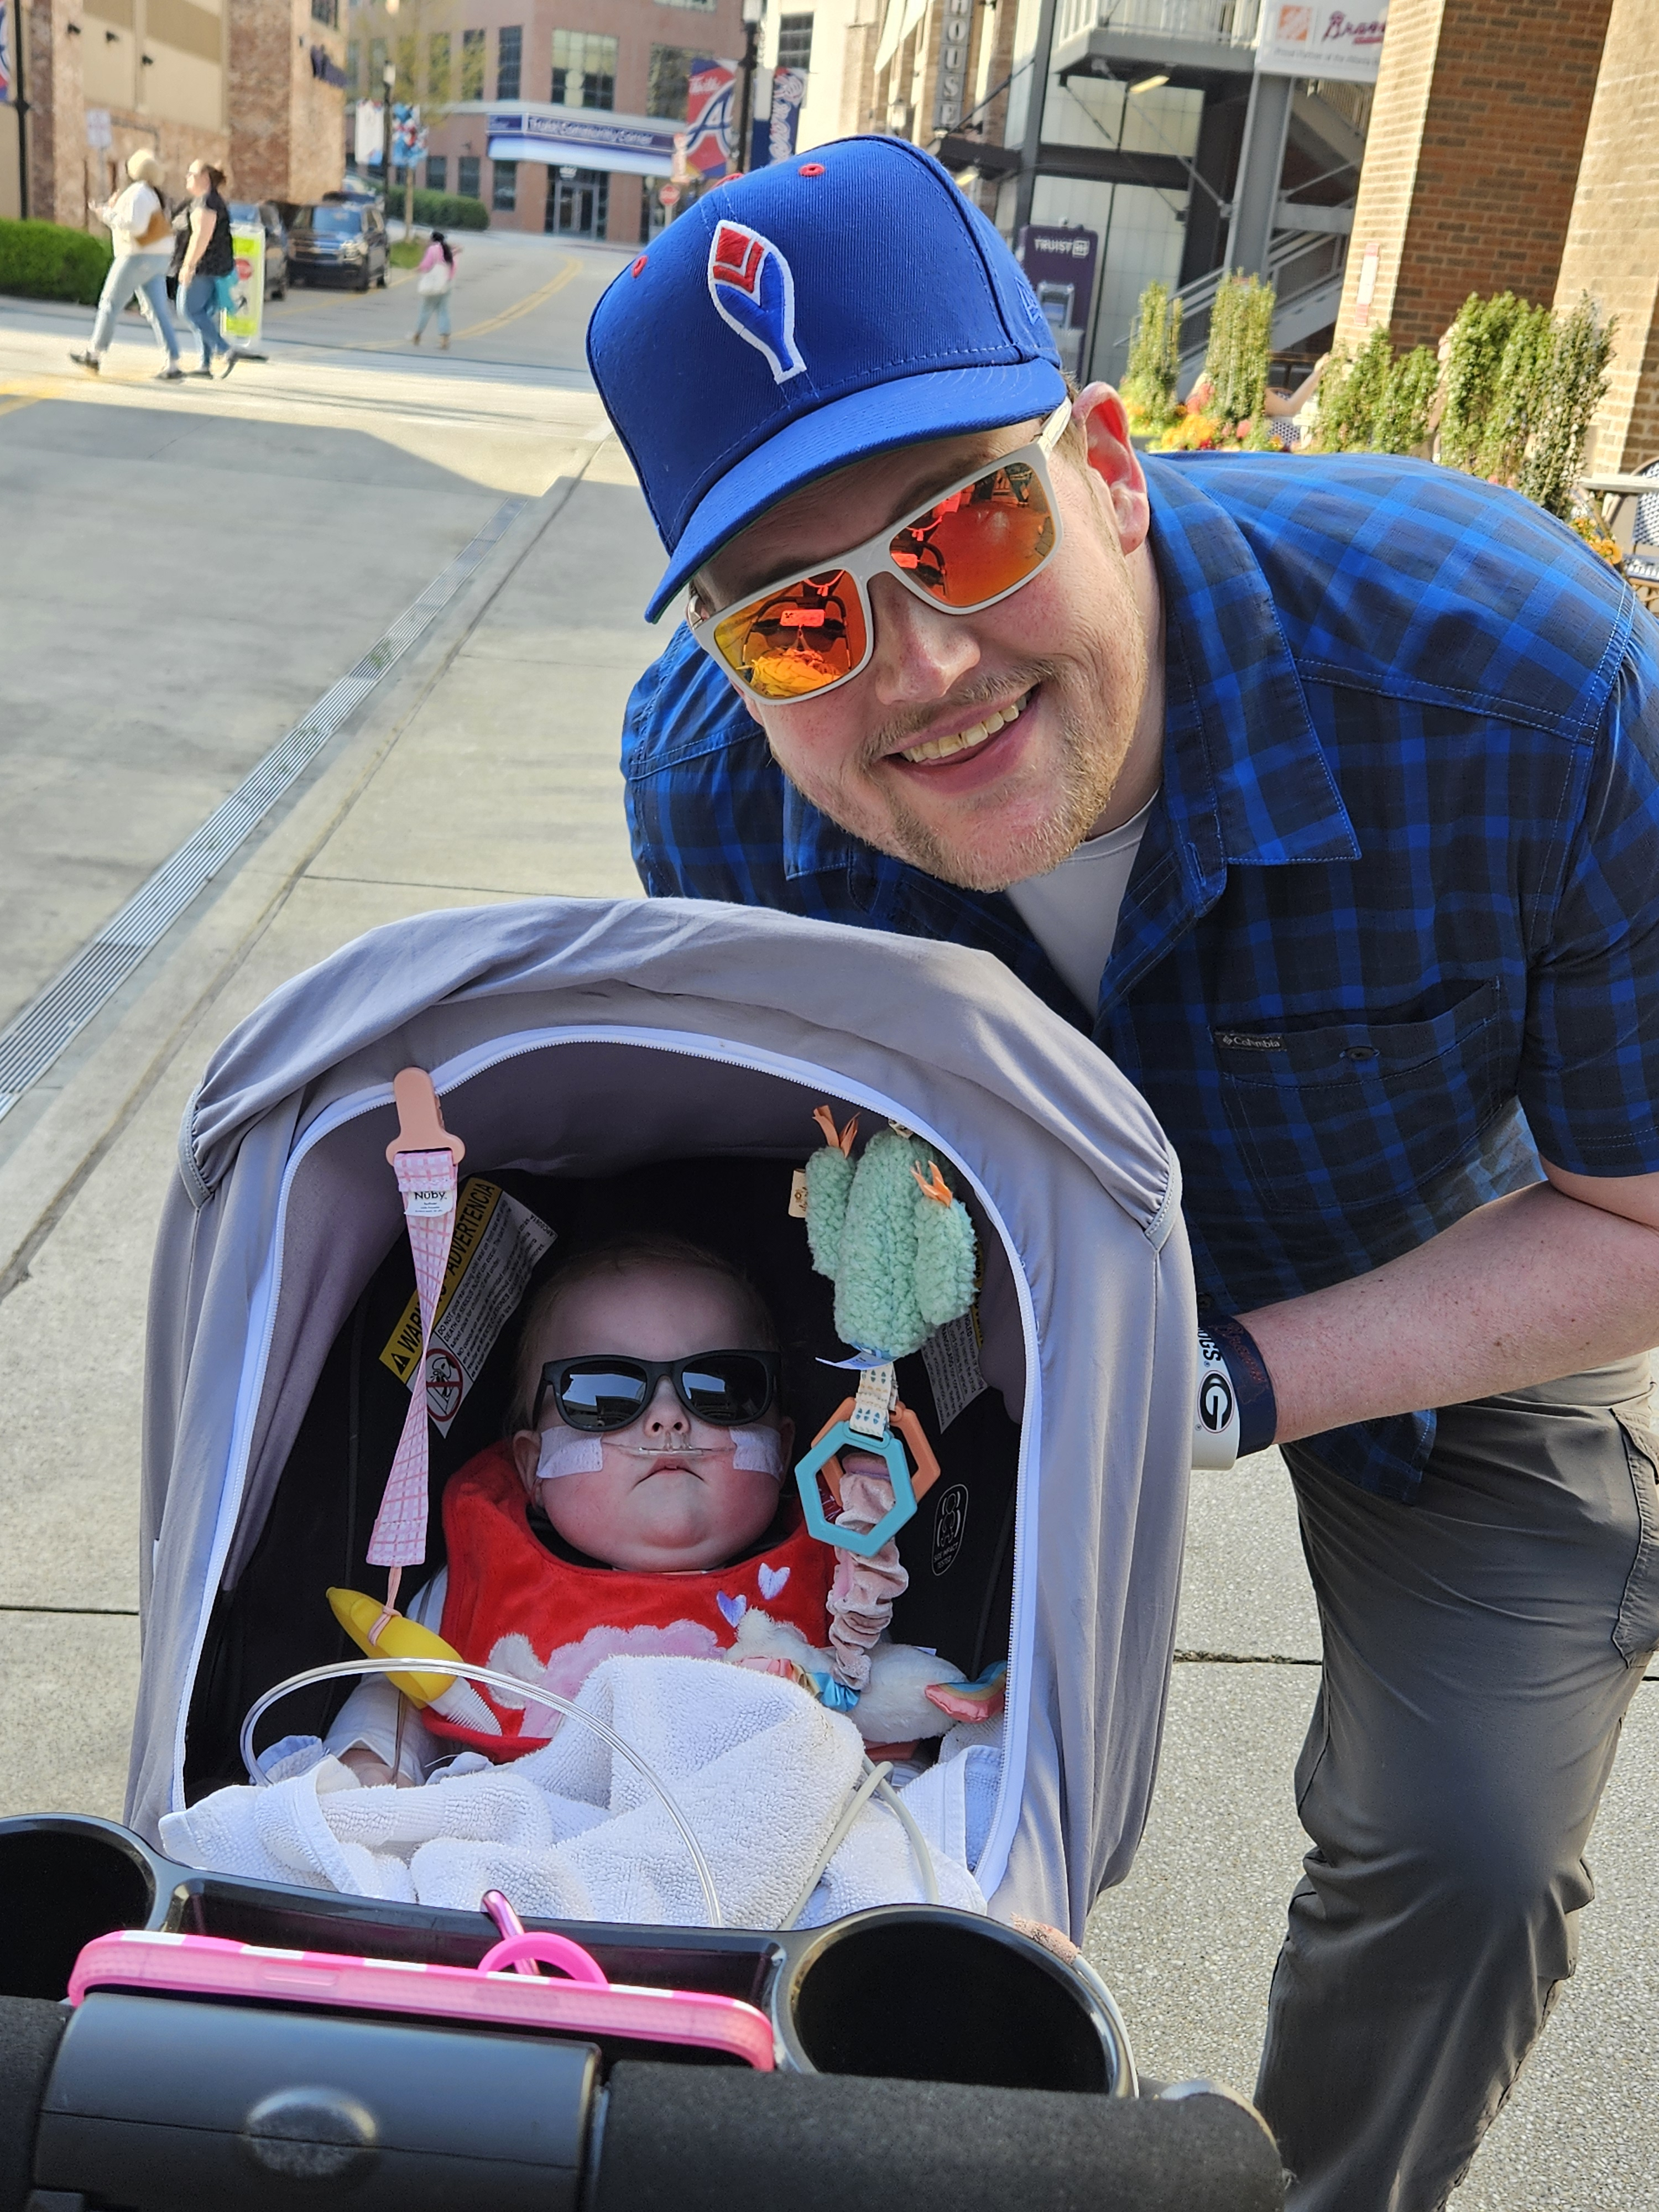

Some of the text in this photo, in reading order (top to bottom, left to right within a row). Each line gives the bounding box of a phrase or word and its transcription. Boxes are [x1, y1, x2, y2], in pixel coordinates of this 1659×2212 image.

[1321, 11, 1386, 42] Brav
[1034, 237, 1073, 254] TRUIST
[446, 1182, 495, 1276] ADVERTENCIA
[437, 1324, 445, 1335] DO
[444, 1311, 453, 1326] NOT
[444, 1321, 456, 1342] DEATH
